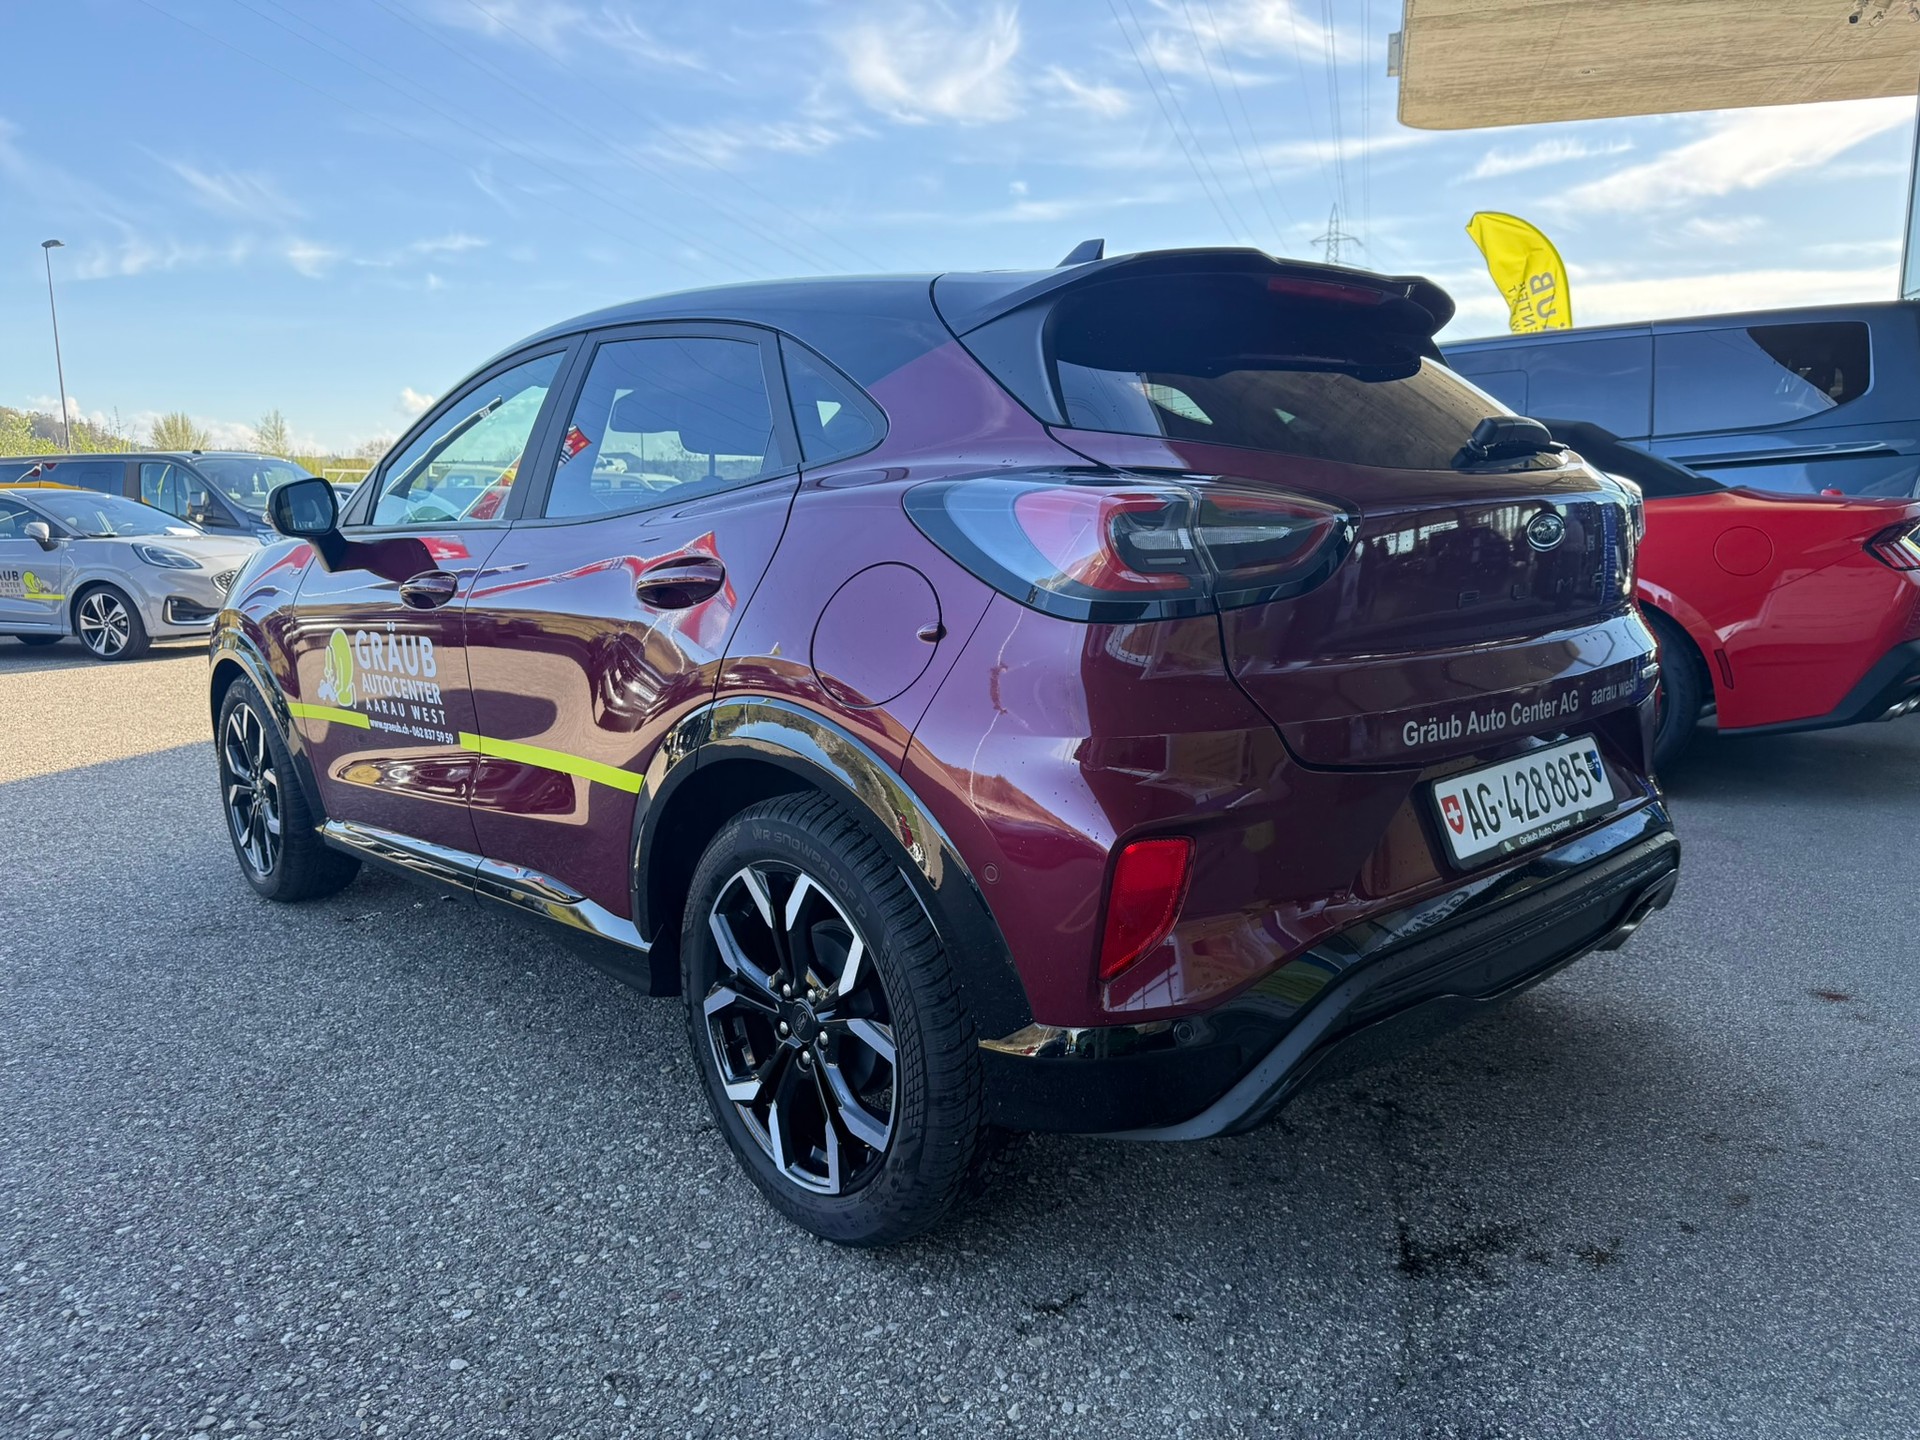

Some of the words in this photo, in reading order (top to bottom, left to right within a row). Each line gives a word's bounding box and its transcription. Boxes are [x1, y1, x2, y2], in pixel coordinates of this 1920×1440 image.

[356, 621, 437, 678] GRÄUB
[361, 672, 443, 706] AUTOCENTER
[1591, 683, 1617, 705] aarau
[365, 697, 406, 718] AARAU
[410, 704, 446, 725] WEST
[1402, 713, 1462, 746] Gräub
[1466, 710, 1506, 736] Auto
[1510, 697, 1558, 726] Center
[1559, 689, 1579, 715] AG
[1538, 825, 1552, 838] Auto
[1551, 819, 1571, 833] Center
